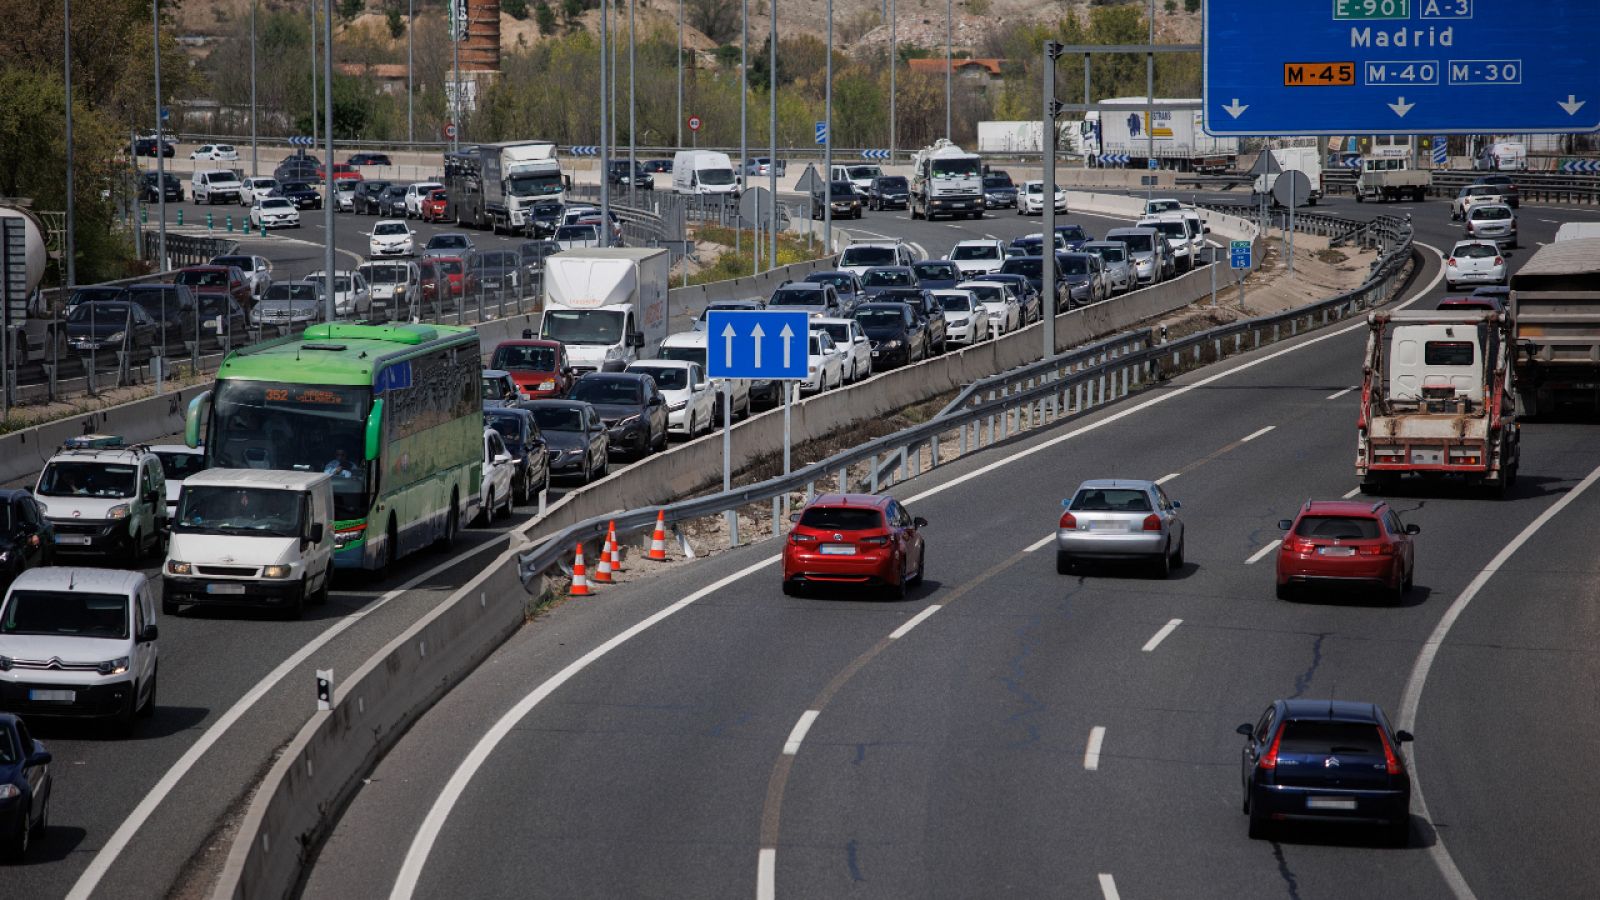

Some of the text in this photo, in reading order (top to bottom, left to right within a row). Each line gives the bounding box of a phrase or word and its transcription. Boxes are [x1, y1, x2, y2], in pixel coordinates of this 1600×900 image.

[1336, 0, 1406, 16] E-901
[1424, 0, 1468, 16] A-3
[1350, 26, 1454, 48] Madrid
[1288, 65, 1352, 83] M-45
[1368, 64, 1434, 82] M-40
[1452, 64, 1517, 81] M-30
[265, 388, 289, 401] 352
